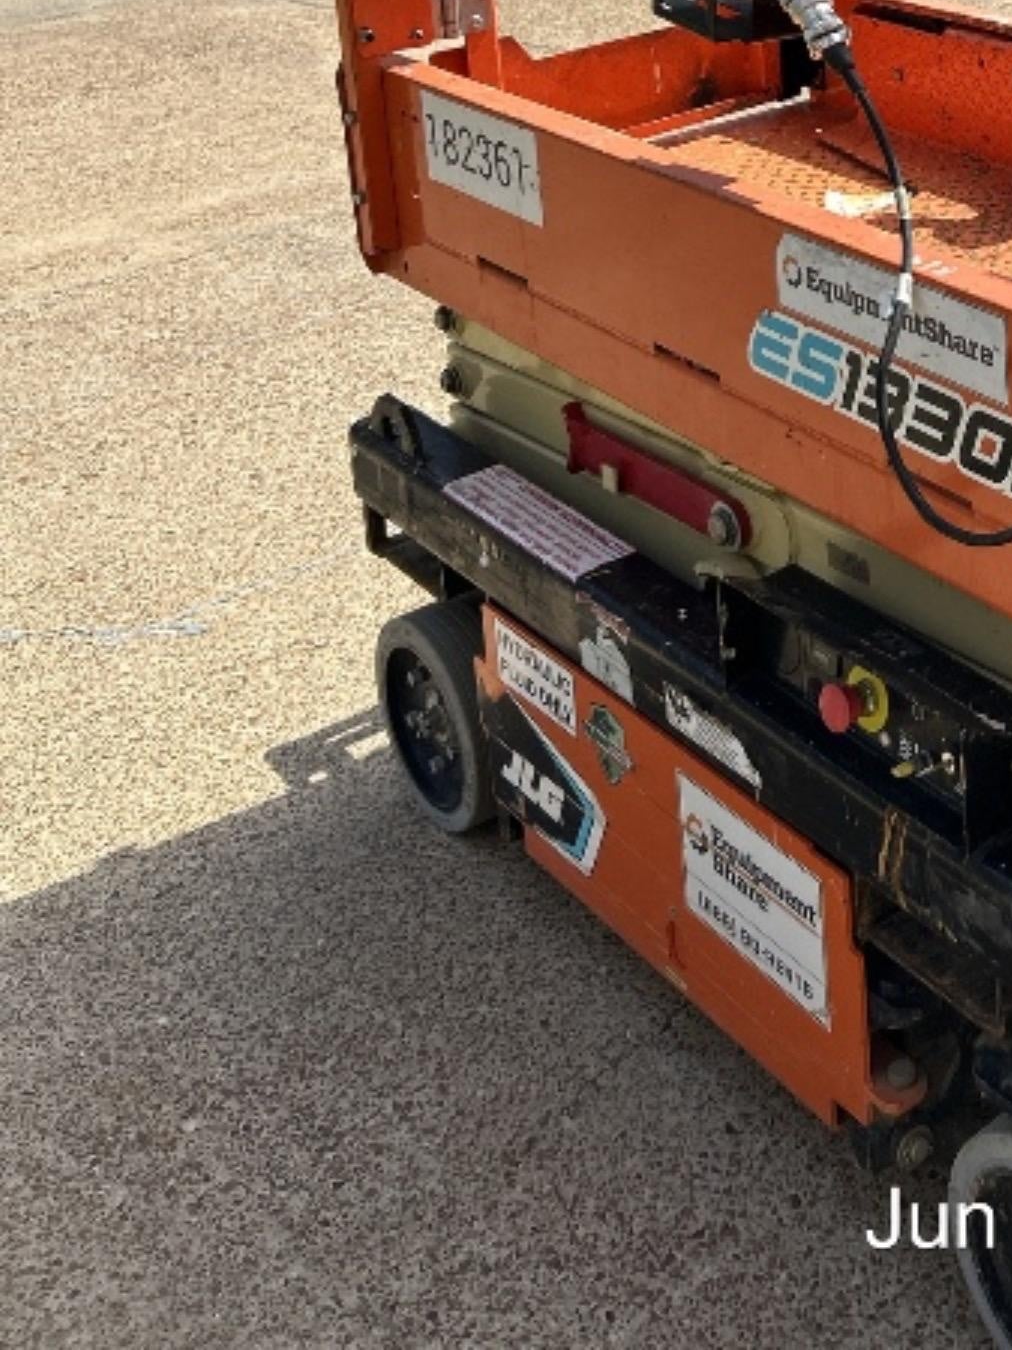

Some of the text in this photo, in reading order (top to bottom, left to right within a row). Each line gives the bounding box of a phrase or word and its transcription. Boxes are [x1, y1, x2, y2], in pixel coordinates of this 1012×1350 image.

[806, 264, 996, 368] EquipmntShare
[501, 749, 564, 824] JLG
[710, 821, 817, 928] Equipment
[713, 848, 769, 913] Share
